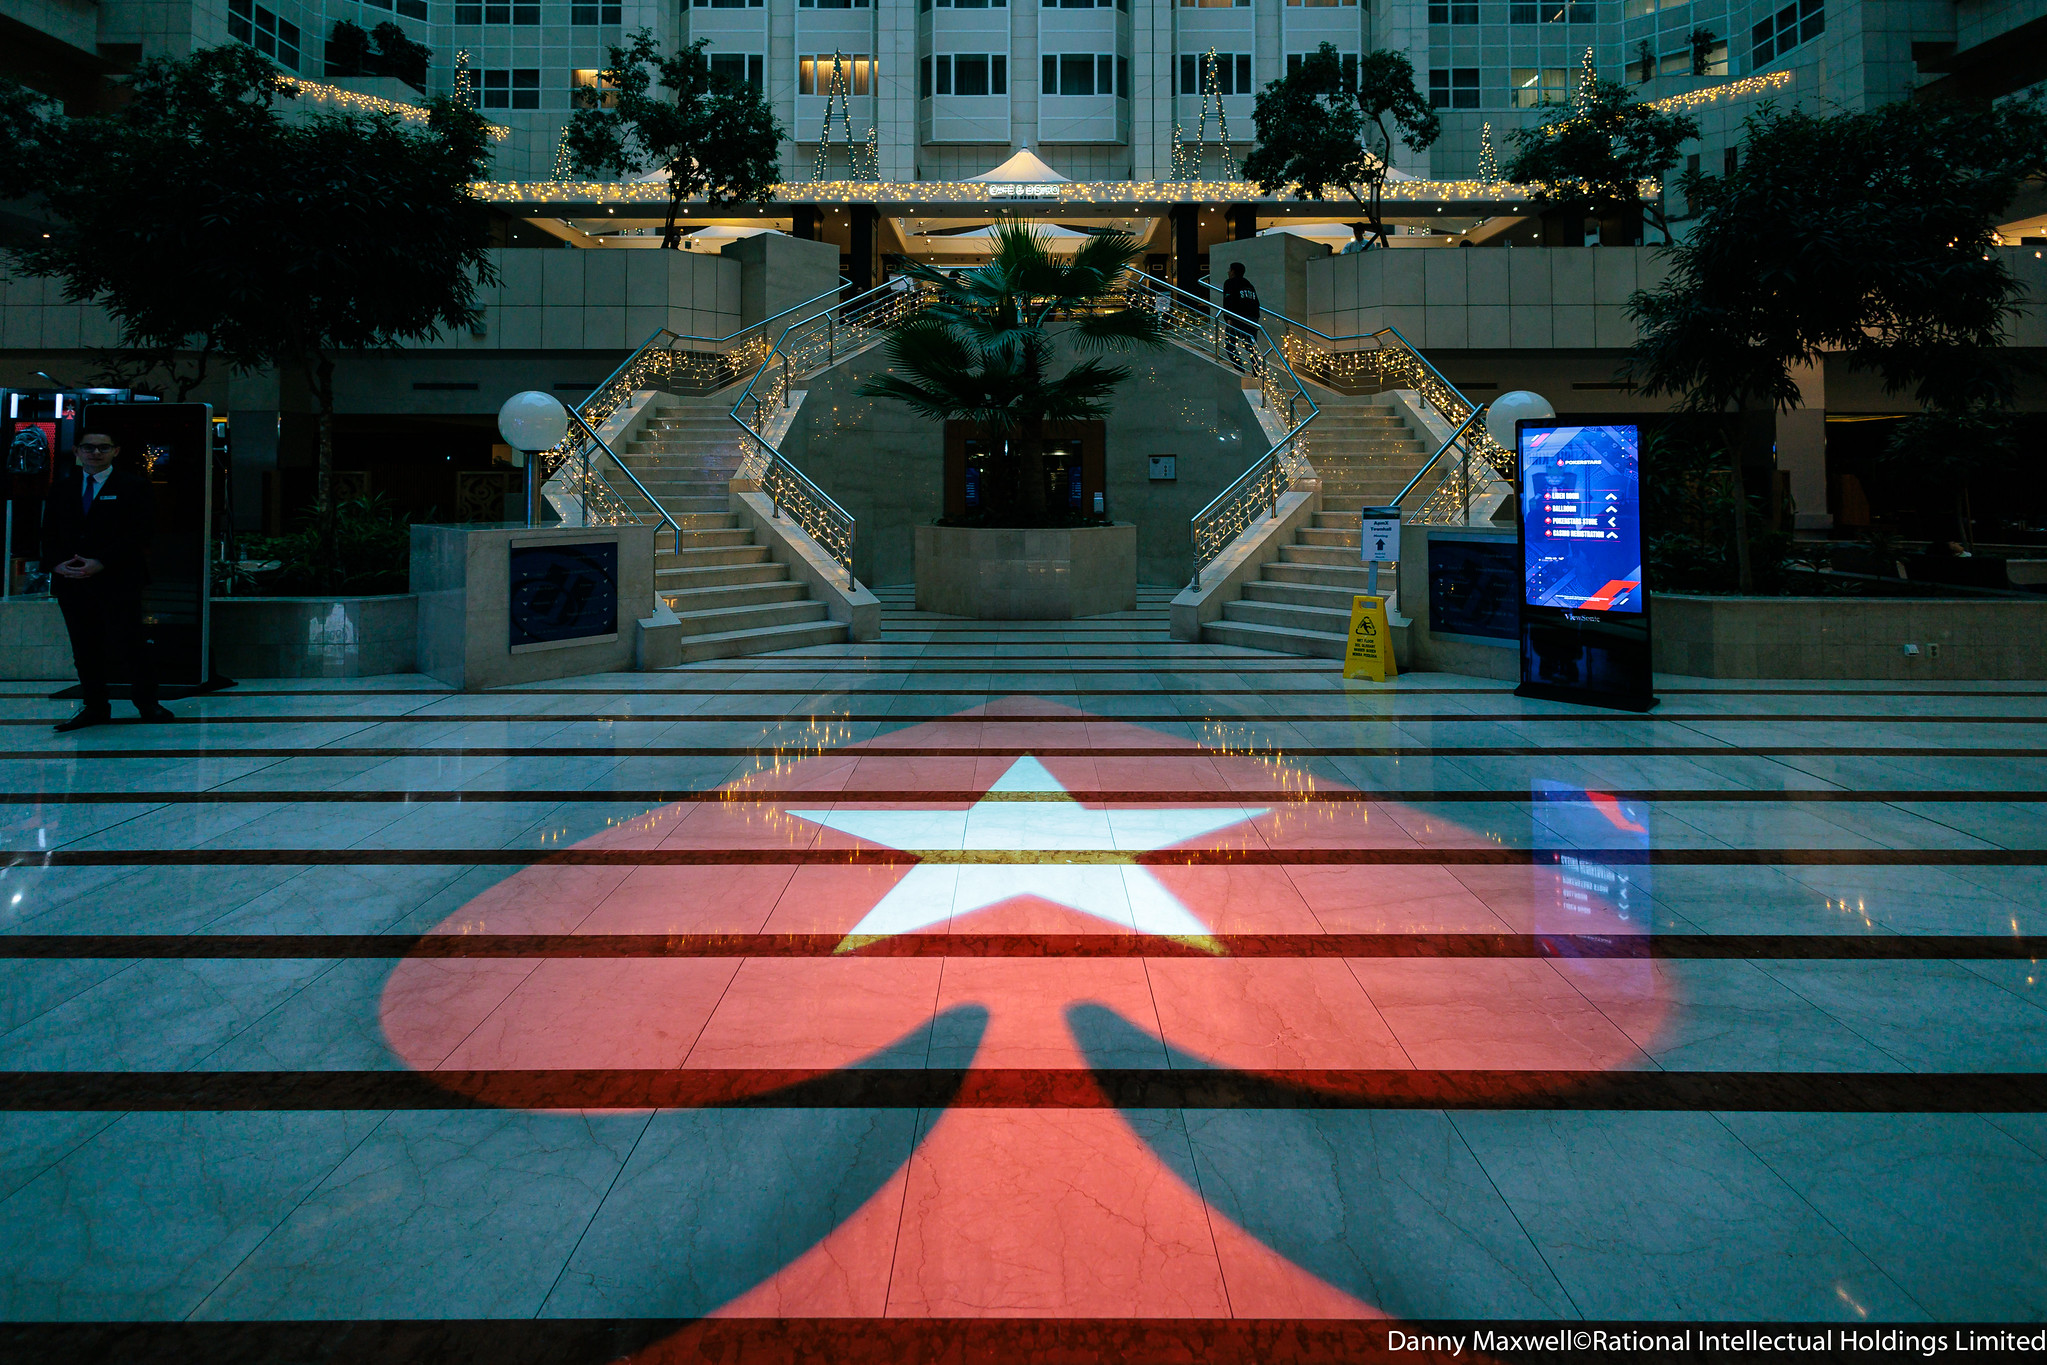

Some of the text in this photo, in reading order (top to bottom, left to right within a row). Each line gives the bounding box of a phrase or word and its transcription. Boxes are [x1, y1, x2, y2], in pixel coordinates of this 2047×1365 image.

[1025, 184, 1059, 195] BISTRO
[1552, 505, 1577, 513] BALLROOM
[1552, 517, 1598, 526] POKERSTARS STORE
[1570, 530, 1605, 538] REGISTRATION
[1564, 613, 1601, 623] ViewSonic
